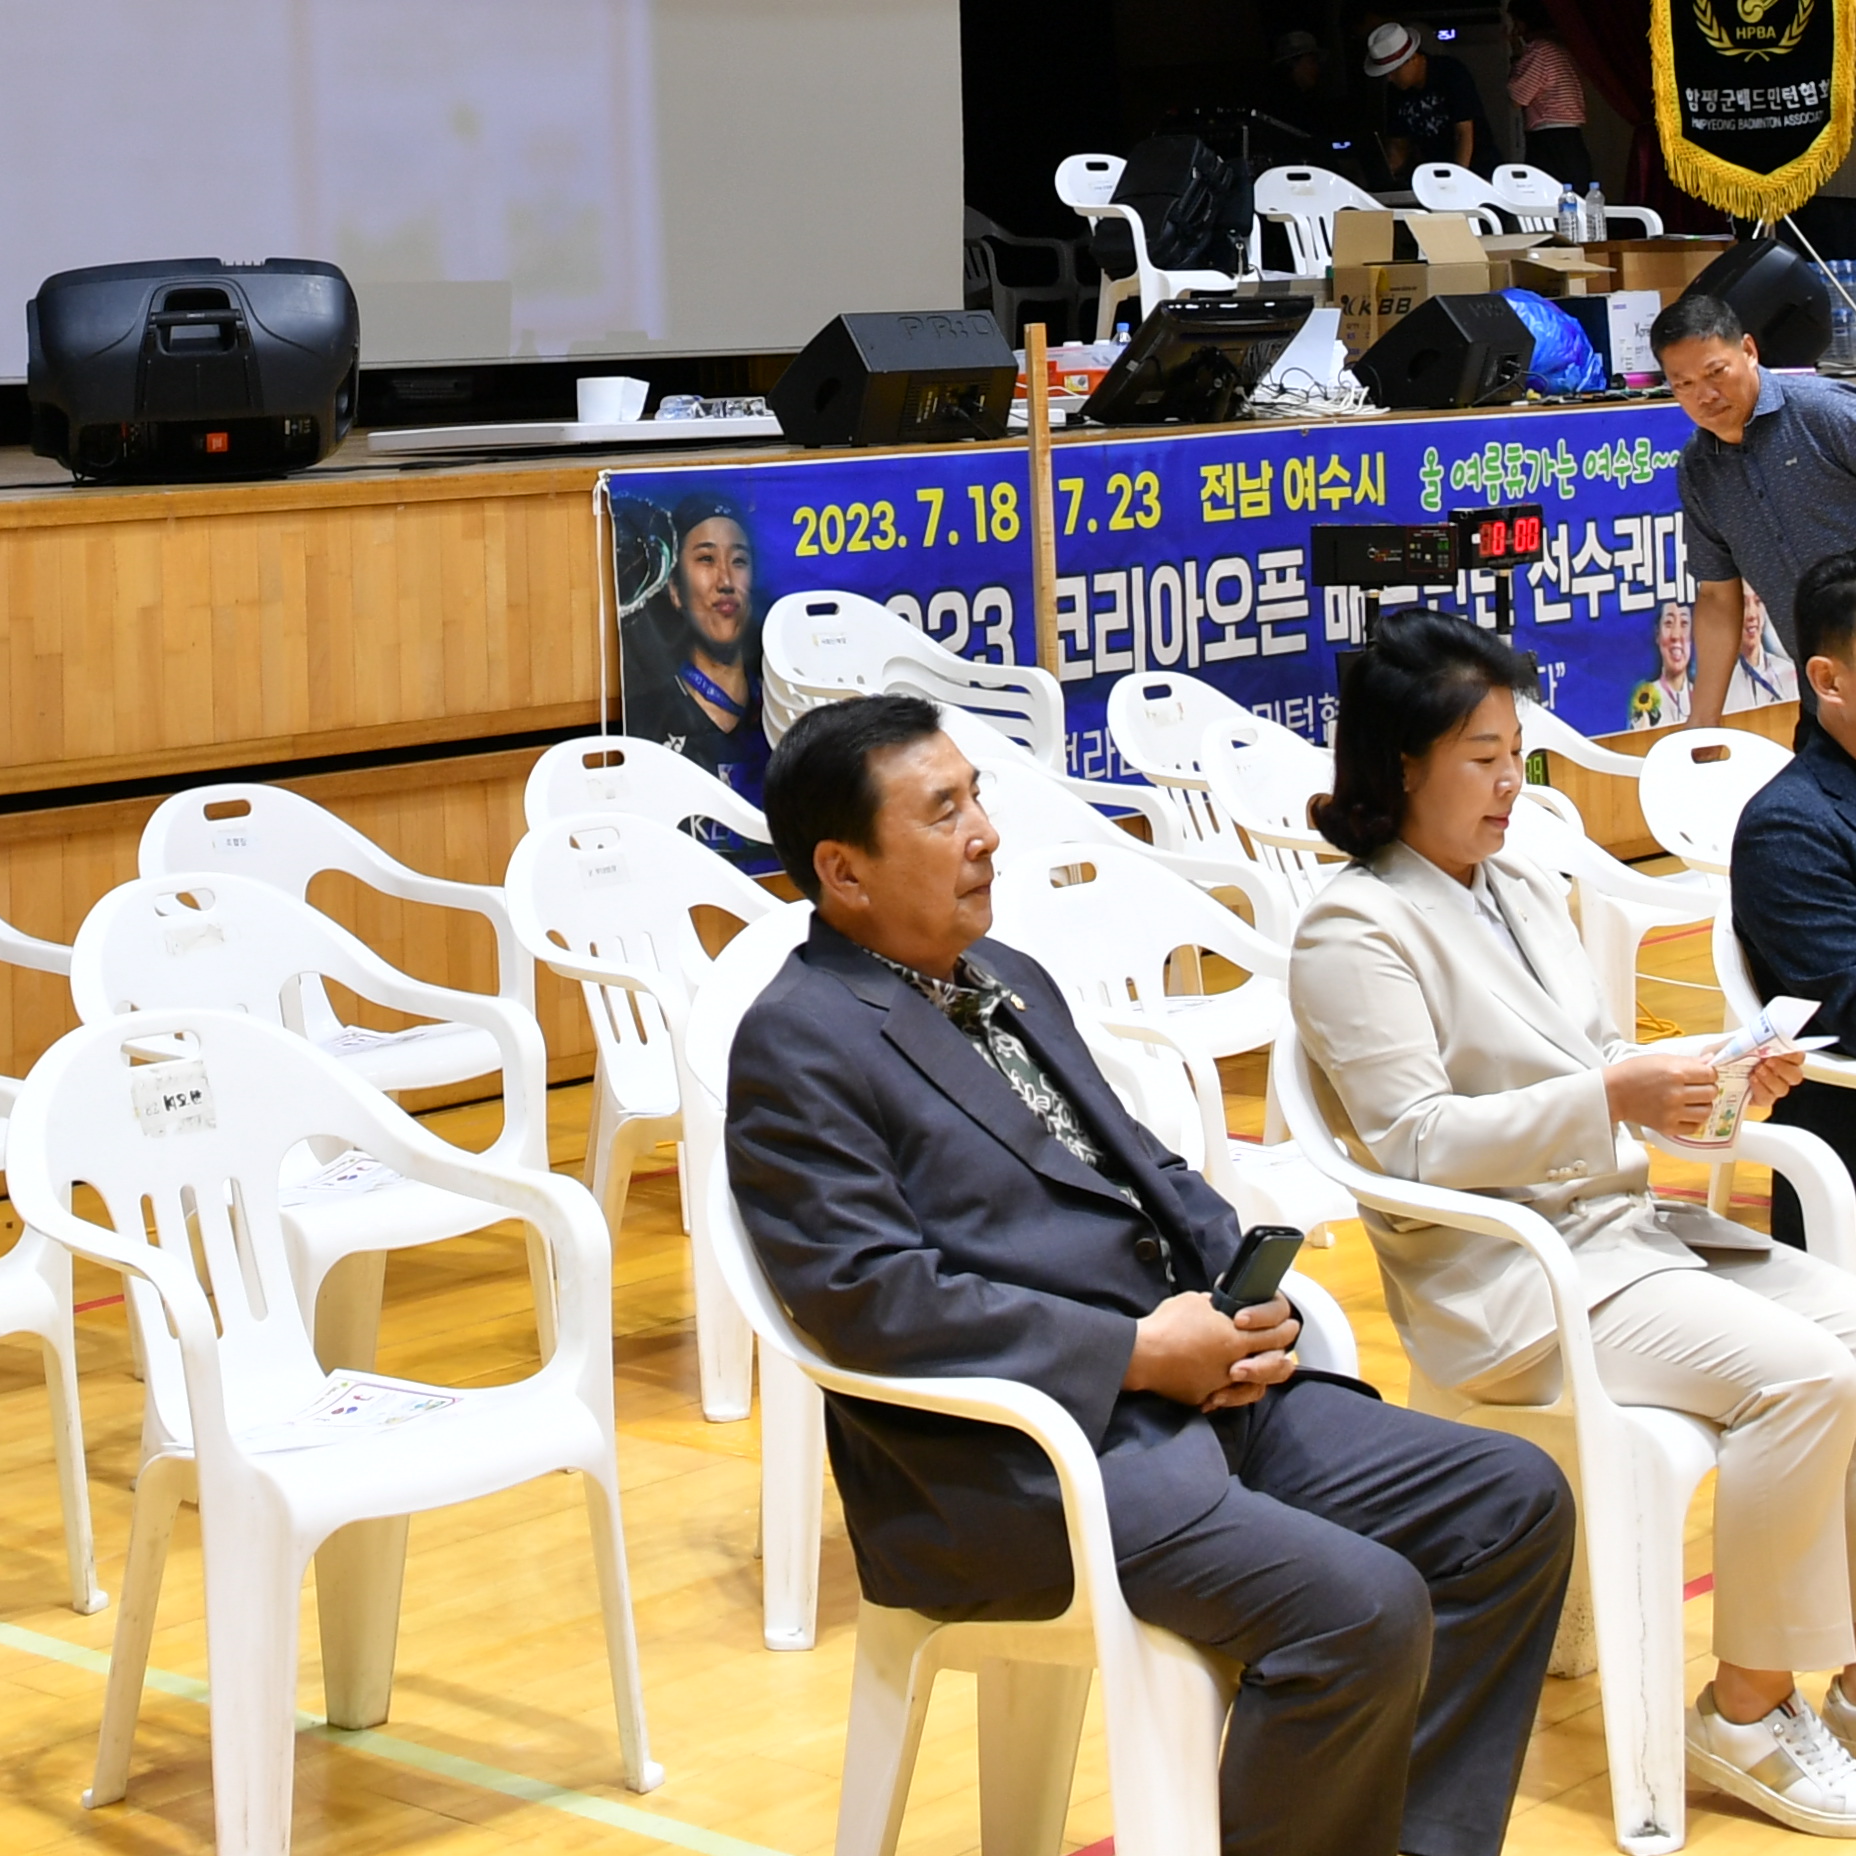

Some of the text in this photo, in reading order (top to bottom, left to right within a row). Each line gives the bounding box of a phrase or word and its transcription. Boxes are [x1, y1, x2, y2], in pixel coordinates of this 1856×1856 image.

[1736, 26, 1776, 40] HPBA
[1200, 451, 1386, 522] 전남 여수시
[1420, 446, 1444, 512] 올
[1451, 437, 1578, 506] 여름휴가는
